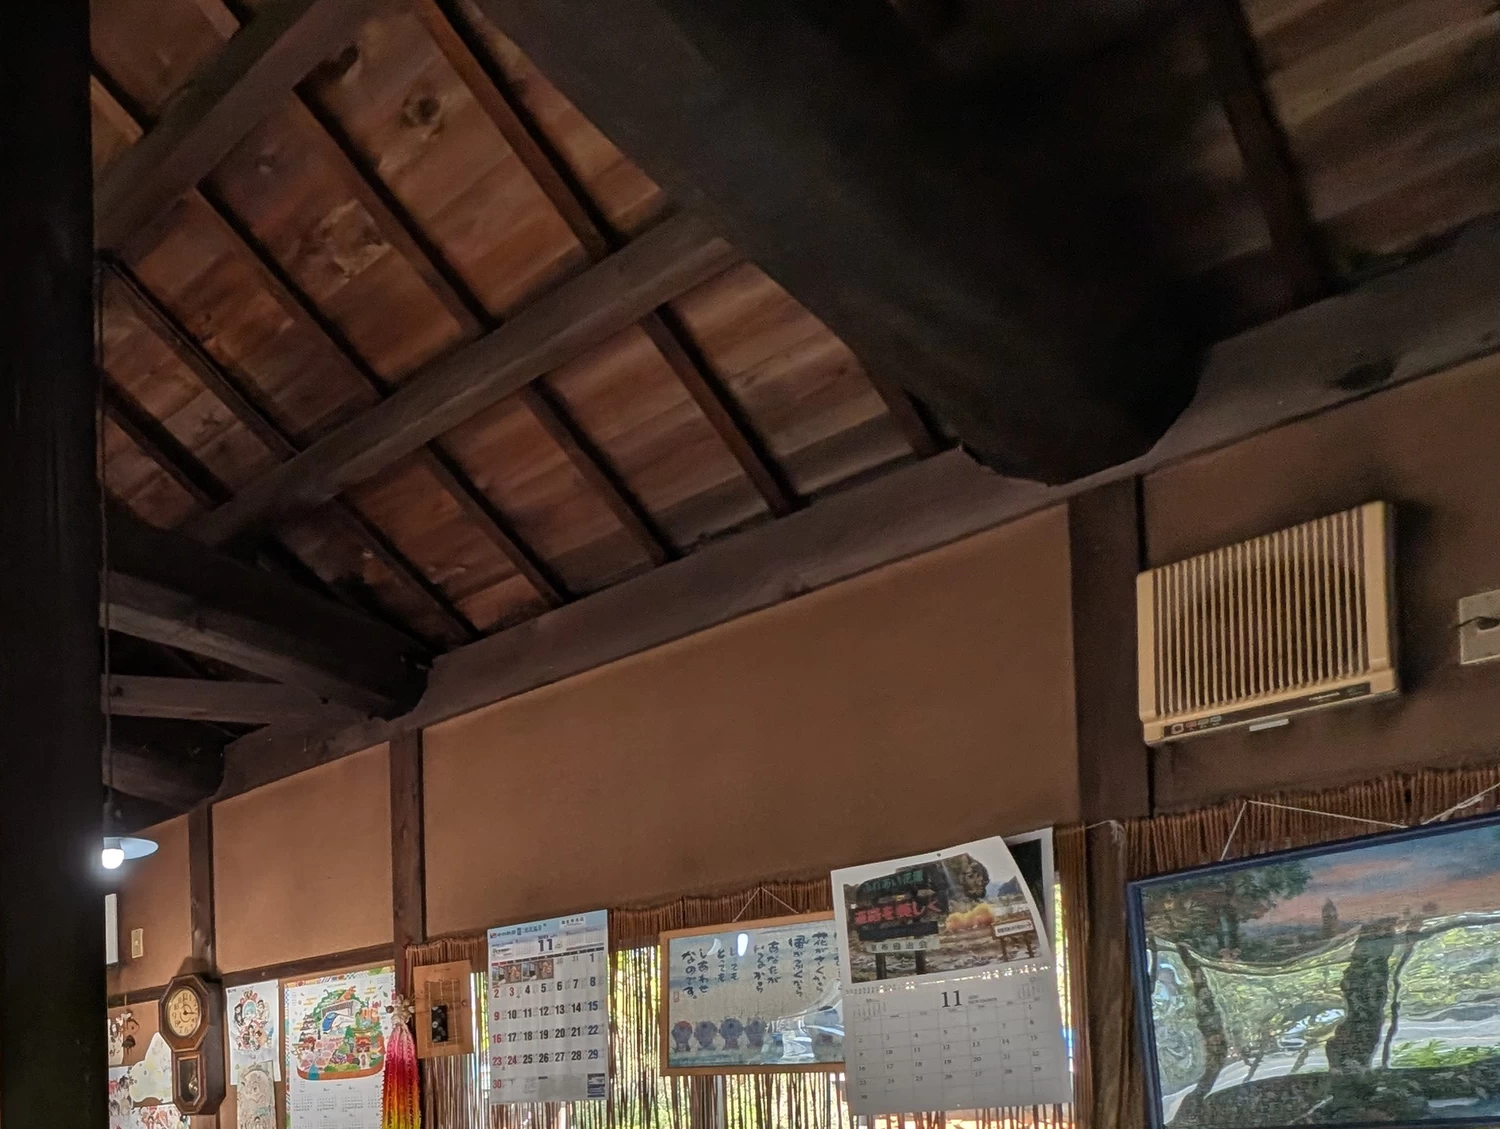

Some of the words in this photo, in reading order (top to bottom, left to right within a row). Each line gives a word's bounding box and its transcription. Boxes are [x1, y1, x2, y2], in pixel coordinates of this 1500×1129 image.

[538, 938, 553, 952] 11
[697, 948, 709, 993] しあわせ
[767, 941, 781, 984] あなたが
[494, 989, 499, 998] 2
[509, 987, 514, 996] 3
[525, 985, 530, 994] 4
[541, 983, 546, 993] 5
[557, 981, 562, 991] 6
[573, 979, 579, 989] 7
[590, 976, 596, 987] 8
[941, 990, 962, 1008] 11
[494, 1011, 500, 1020] 9
[507, 1010, 517, 1019] 10
[523, 1008, 532, 1018] 11
[539, 1006, 549, 1016] 12
[555, 1005, 565, 1015] 13
[571, 1003, 581, 1013] 14
[588, 1001, 598, 1011] 15
[492, 1034, 501, 1043] 16
[507, 1033, 517, 1042] 17
[523, 1031, 532, 1041] 18
[539, 1030, 549, 1039] 19
[555, 1028, 565, 1038] 20
[571, 1026, 580, 1037] 21
[588, 1025, 598, 1035] 22
[492, 1056, 502, 1066] 23
[507, 1055, 517, 1065] 24
[523, 1055, 532, 1064] 25
[539, 1053, 549, 1063] 26
[555, 1051, 565, 1062] 27
[571, 1050, 581, 1060] 28
[588, 1049, 598, 1059] 29
[492, 1079, 502, 1089] 30
